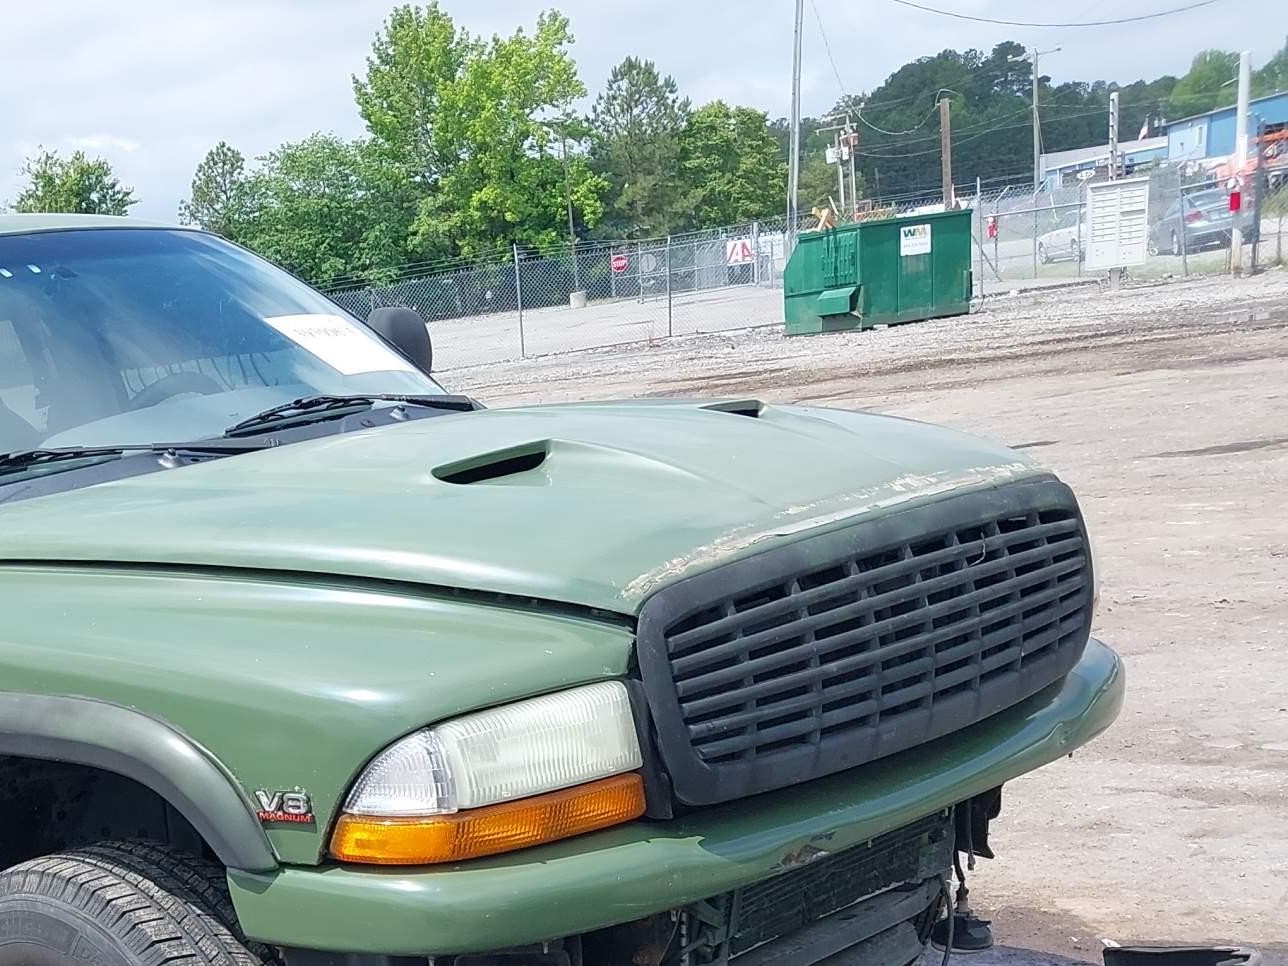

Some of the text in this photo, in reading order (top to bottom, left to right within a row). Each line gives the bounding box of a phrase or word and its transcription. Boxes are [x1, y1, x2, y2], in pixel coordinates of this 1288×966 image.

[903, 227, 927, 238] WM
[255, 790, 309, 814] V8
[258, 811, 313, 823] MAGNUM
